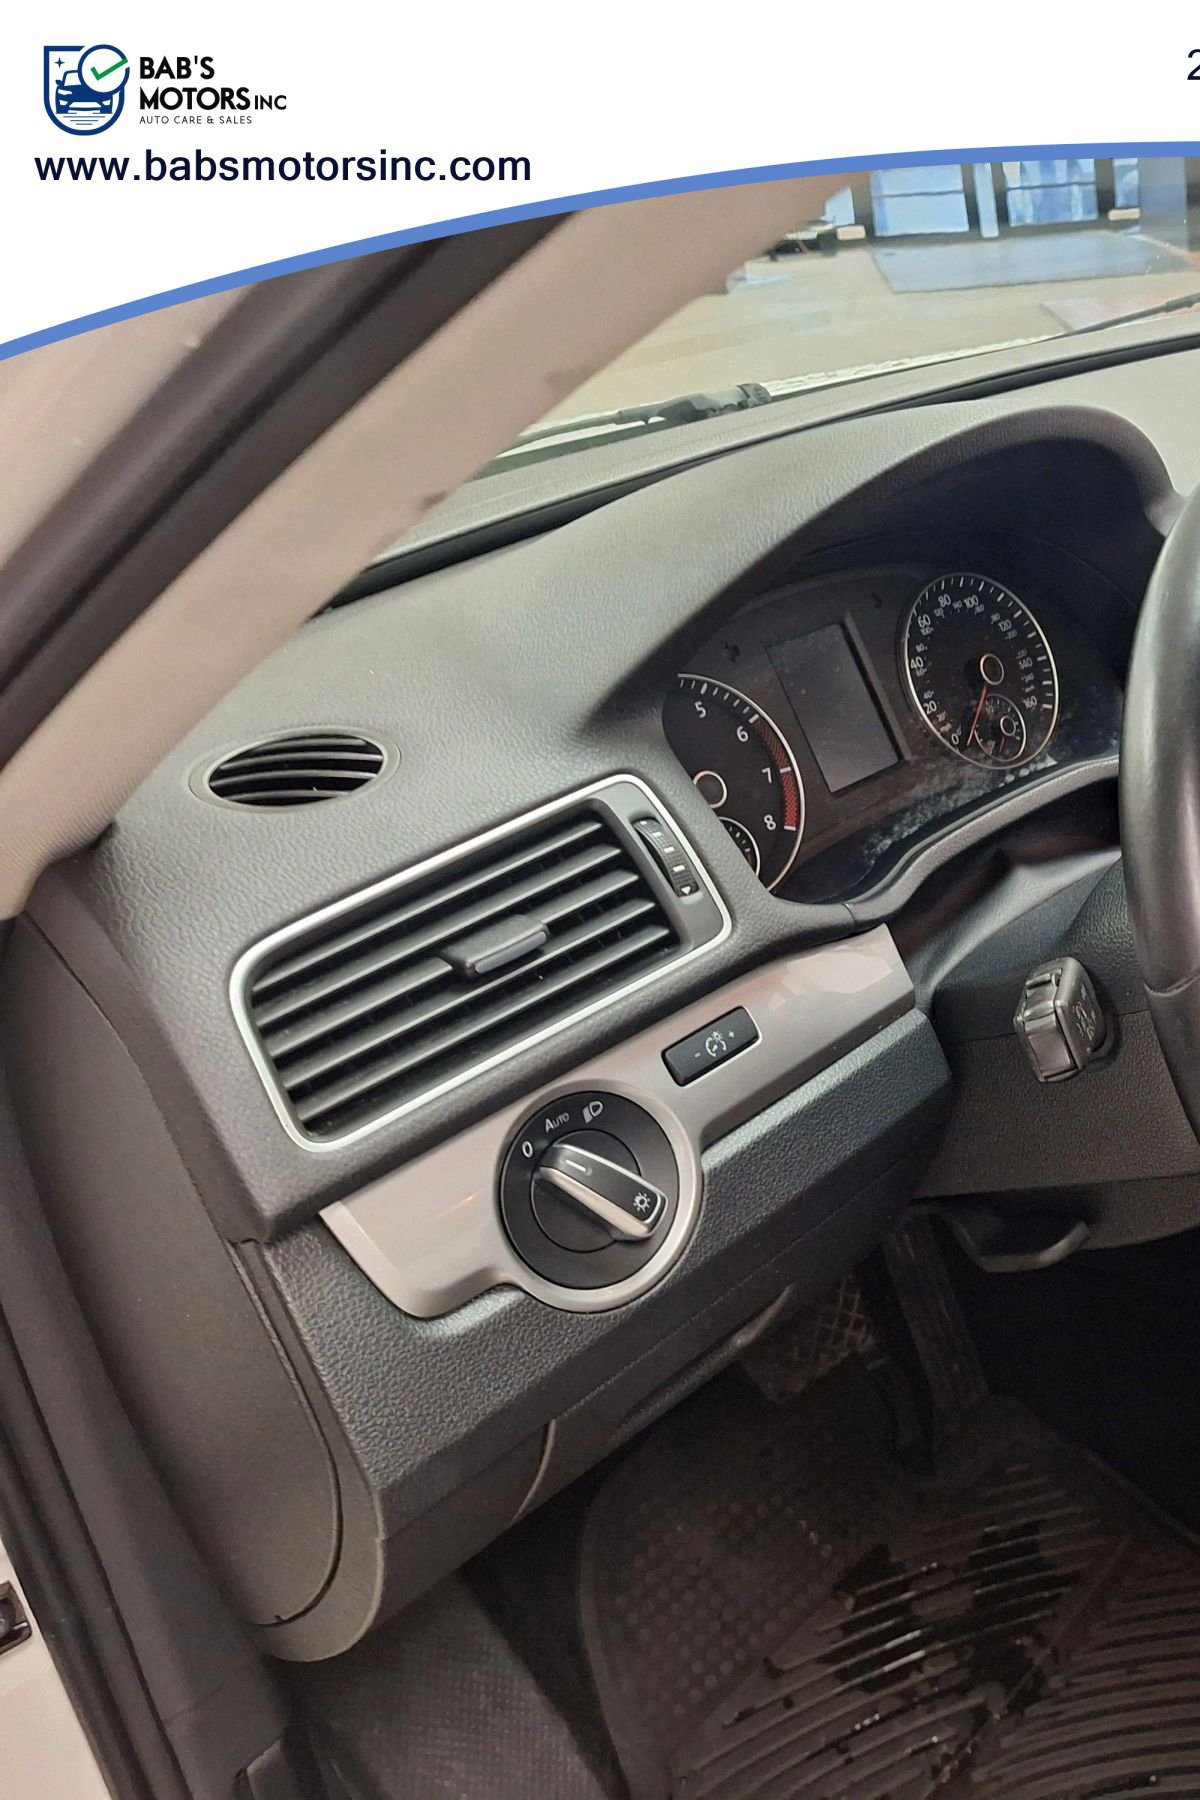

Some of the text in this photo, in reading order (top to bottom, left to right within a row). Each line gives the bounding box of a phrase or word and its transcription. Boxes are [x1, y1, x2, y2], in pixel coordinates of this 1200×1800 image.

[938, 594, 951, 607] 80
[964, 595, 978, 607] 100
[918, 615, 930, 627] 60
[910, 655, 924, 669] 40
[693, 701, 707, 719] 5
[923, 700, 937, 715] 20
[736, 725, 749, 743] 6
[951, 733, 960, 745] 0
[761, 767, 773, 784] 7
[763, 814, 777, 831] 8
[521, 1140, 534, 1159] 0
